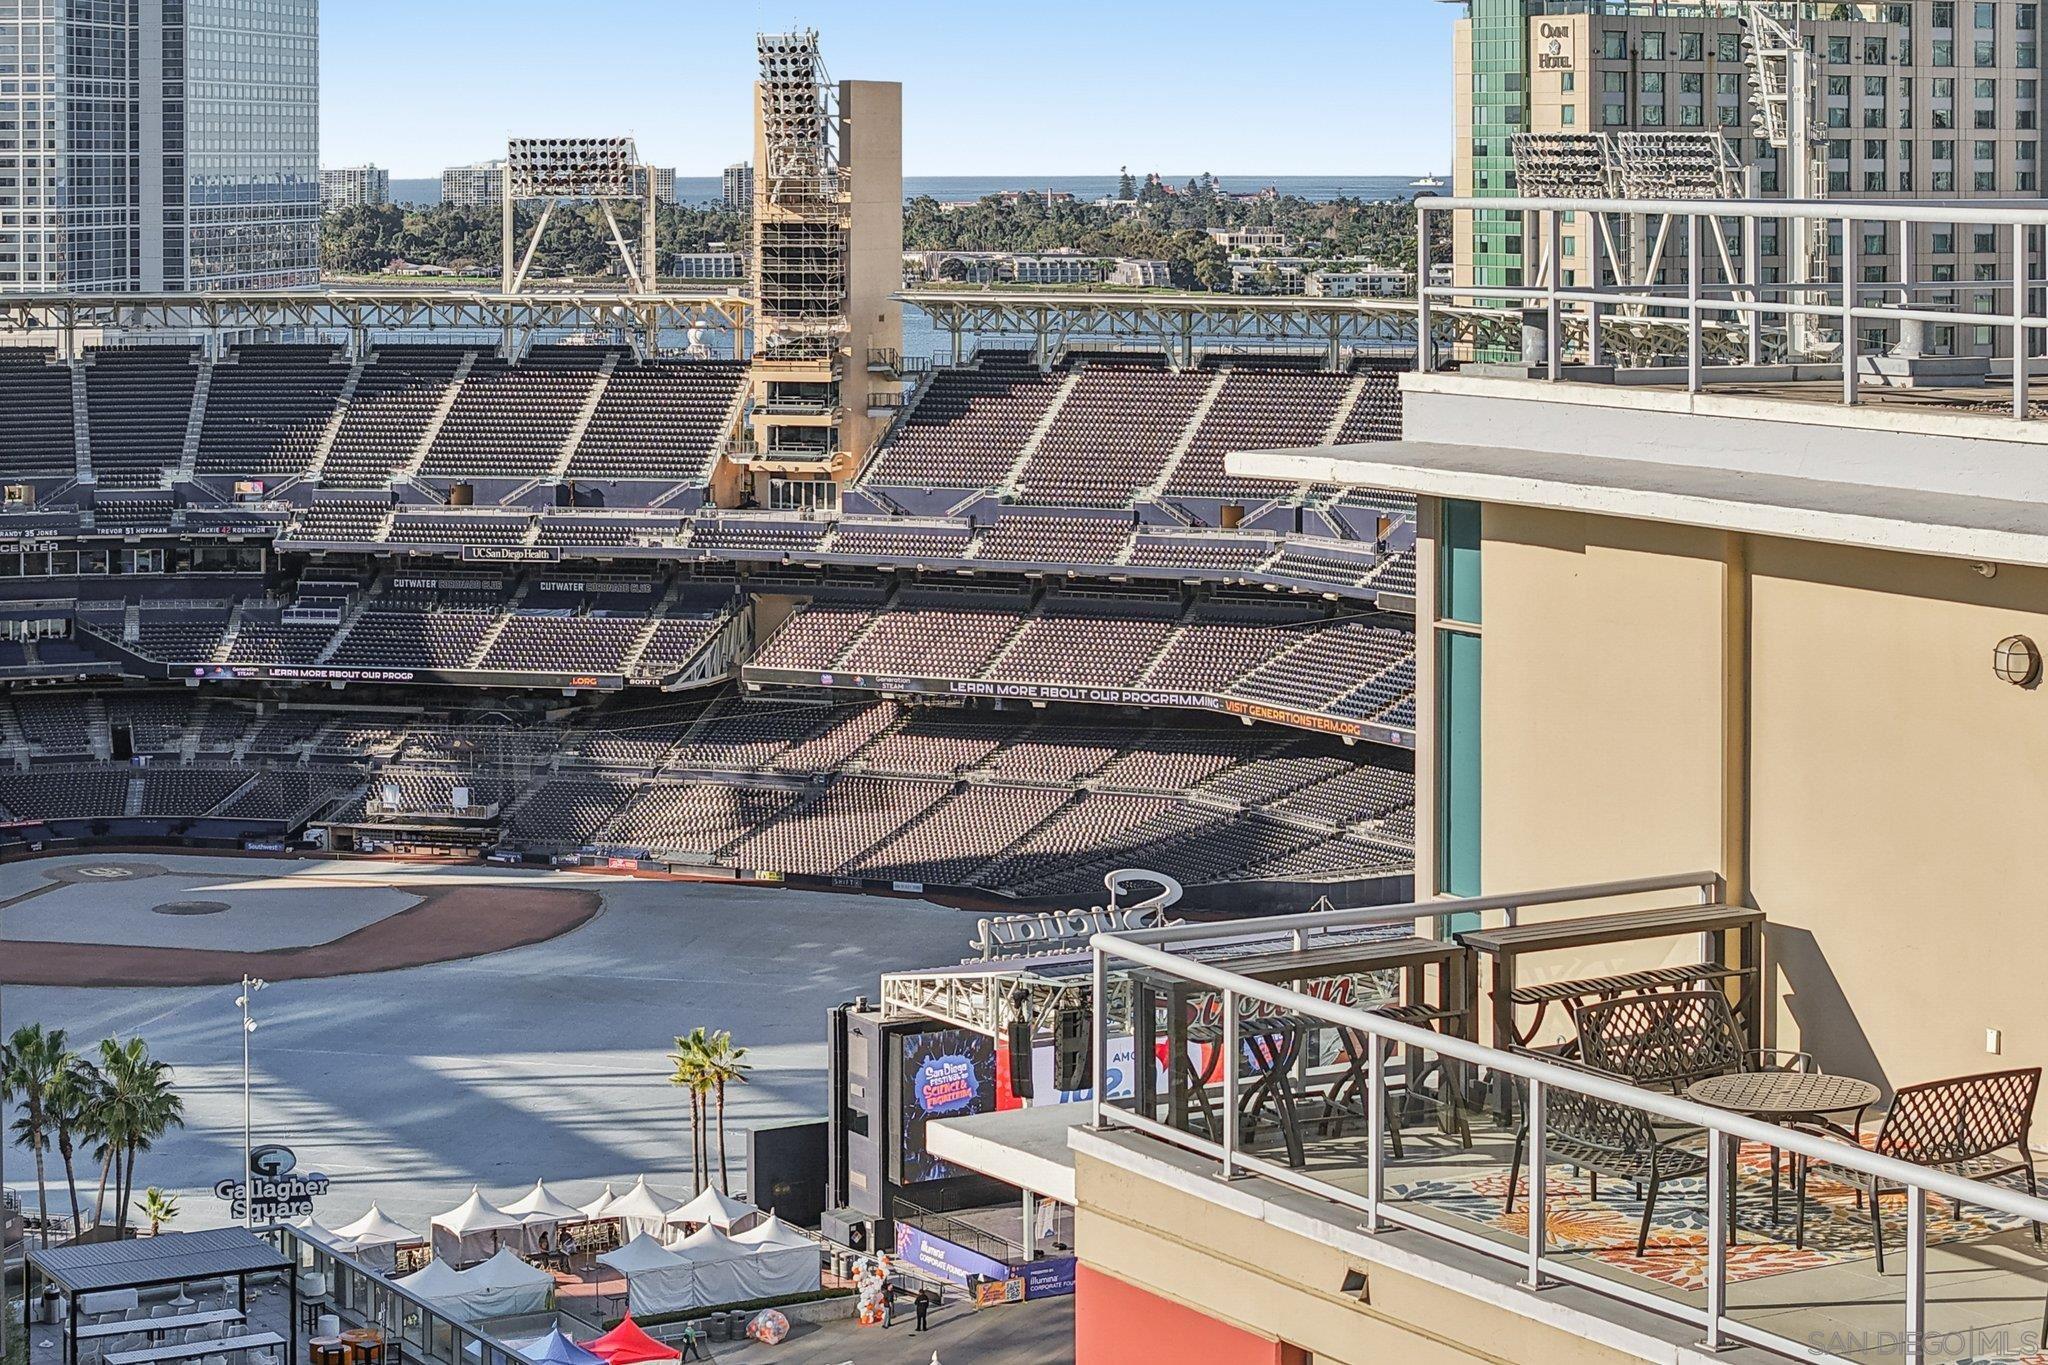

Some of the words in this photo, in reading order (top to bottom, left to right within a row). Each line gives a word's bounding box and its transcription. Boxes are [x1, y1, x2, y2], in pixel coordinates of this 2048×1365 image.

[1538, 53, 1572, 69] HOTEL
[232, 526, 266, 534] ROBINSON
[0, 542, 59, 552] CENTER
[486, 548, 500, 558] San
[501, 548, 524, 560] Diego
[524, 549, 550, 560] Health
[393, 578, 437, 588] CUTWATER
[540, 581, 584, 591] CUTWATER
[269, 668, 299, 676] LEARN
[300, 670, 328, 678] MORE
[329, 671, 361, 679] ABOUT
[382, 672, 414, 680] PROGR
[875, 676, 911, 684] Generation
[950, 681, 994, 695] LEARN
[996, 683, 1038, 697] MORE
[1040, 687, 1088, 699] ABOUT
[1089, 690, 1120, 702] OUR
[1122, 692, 1219, 709] PROGRAMMING
[1225, 700, 1249, 714] VISIT
[1249, 705, 1361, 736] GENERATIONSTEAM.ORG
[925, 1066, 944, 1080] San
[943, 1063, 967, 1076] Diego
[215, 1178, 329, 1201] Gallagher
[232, 1199, 313, 1222] Square
[1030, 1274, 1059, 1286] illumina
[1030, 1282, 1062, 1292] CORPORATE
